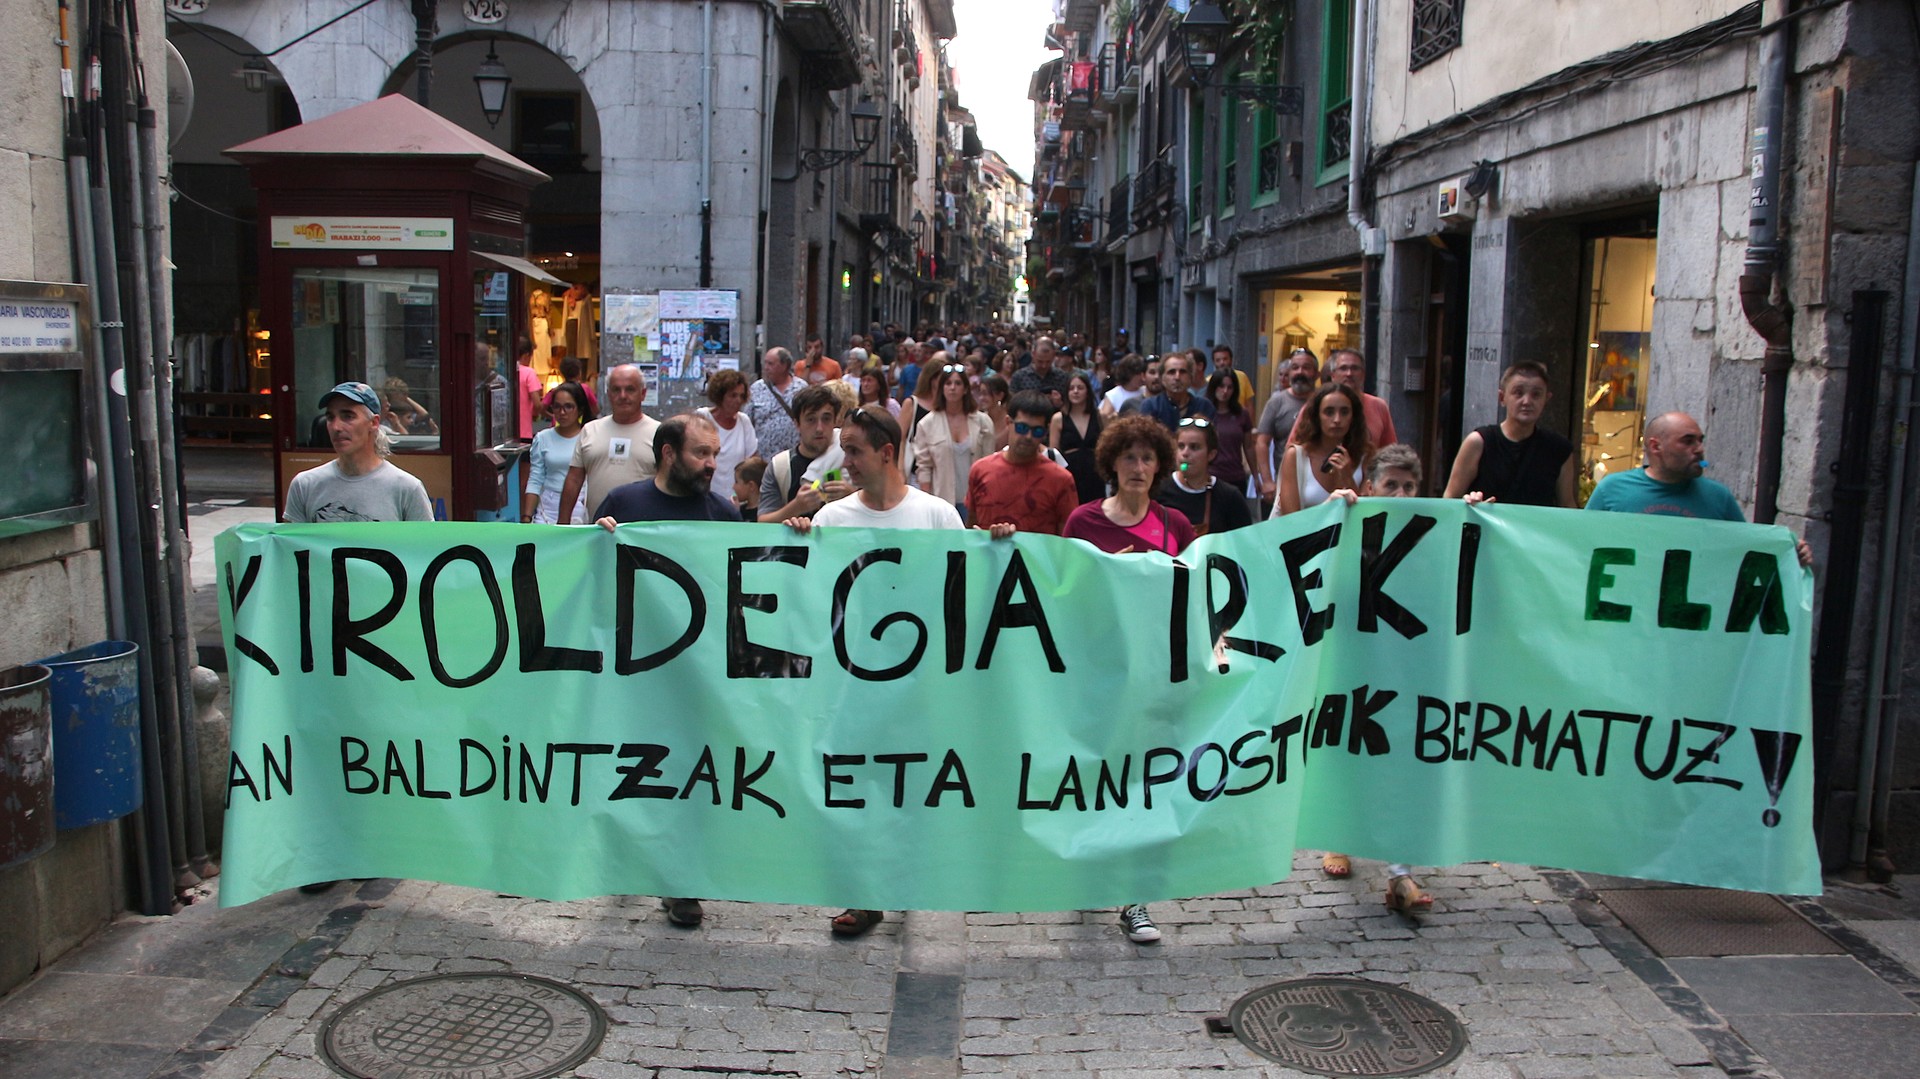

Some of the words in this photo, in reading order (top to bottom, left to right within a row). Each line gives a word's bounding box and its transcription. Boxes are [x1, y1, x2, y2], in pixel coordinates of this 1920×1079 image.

[21, 306, 71, 319] VASCONGADA
[225, 543, 1066, 688] KIROLDEGIA
[1170, 511, 1481, 683] IREKI
[1585, 548, 1790, 635] ELA
[341, 735, 786, 818] BALDINTZAK
[823, 748, 975, 808] ETA
[1018, 684, 1398, 811] LANPOSTAK
[1415, 695, 1802, 828] BERMATUZ!
